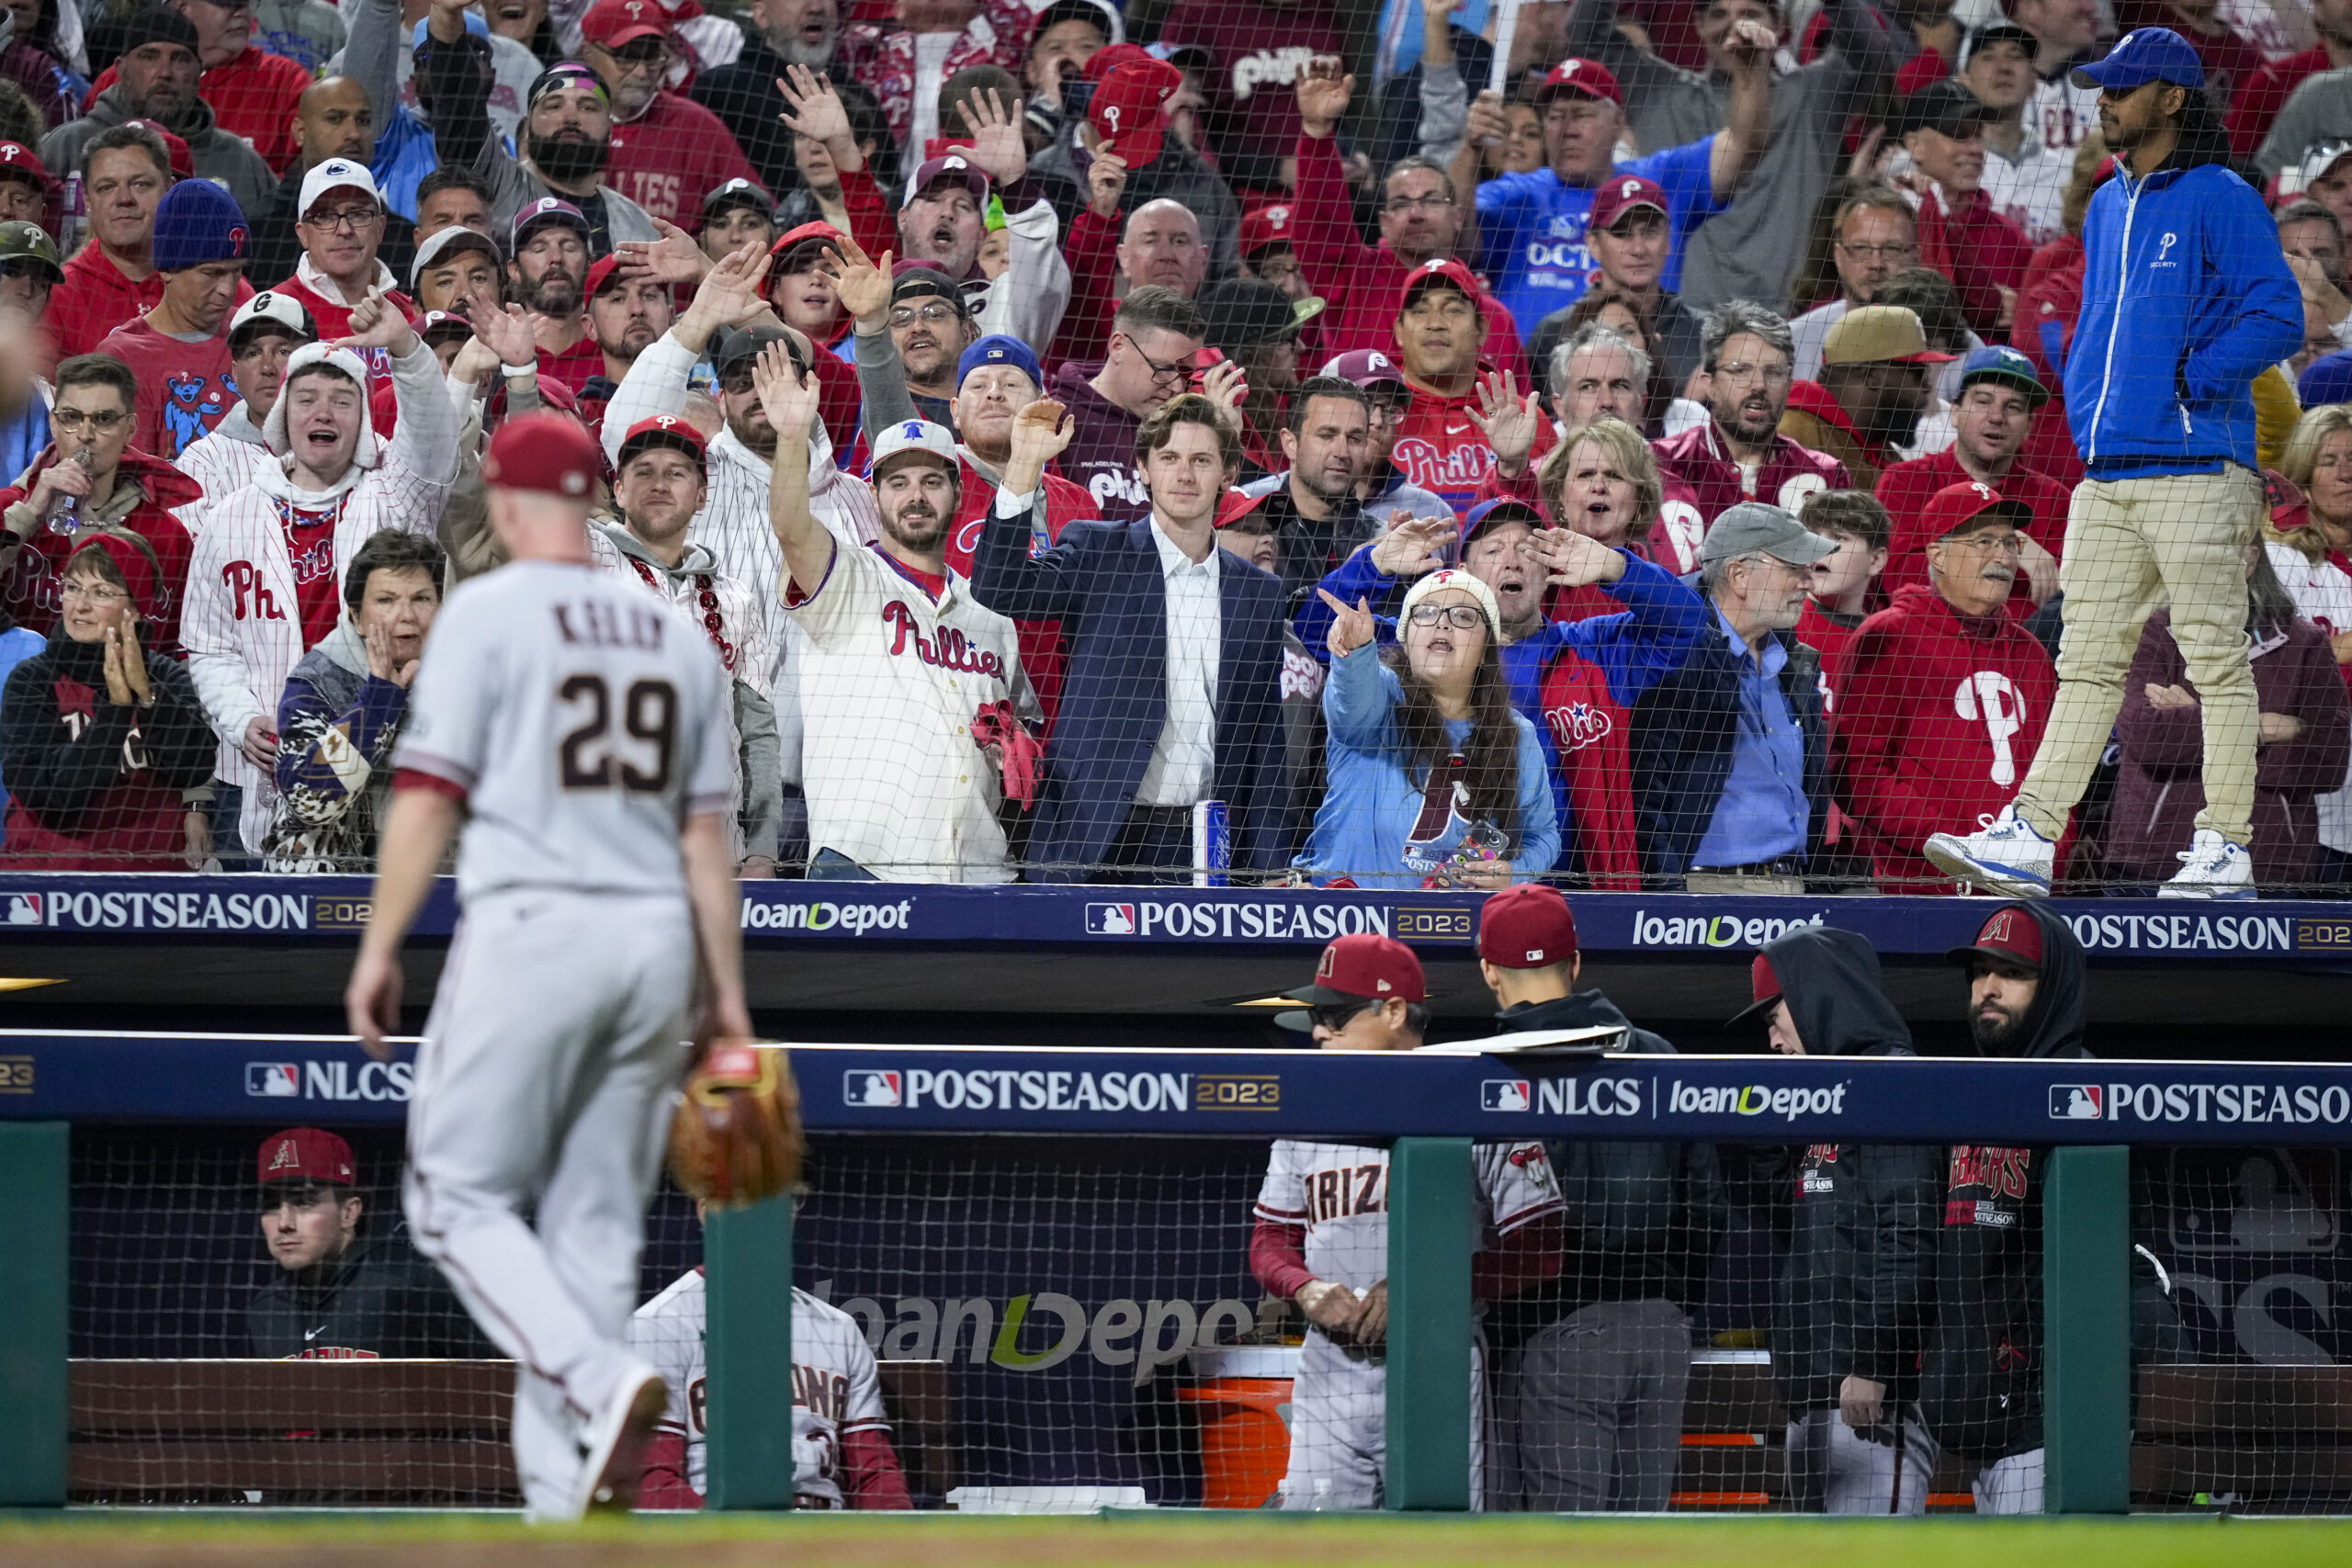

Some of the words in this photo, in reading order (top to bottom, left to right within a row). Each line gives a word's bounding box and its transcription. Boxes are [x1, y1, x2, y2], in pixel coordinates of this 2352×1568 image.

[1103, 106, 1120, 132] P
[1, 144, 20, 161] P
[24, 227, 43, 249] P
[230, 228, 246, 256] P
[2159, 232, 2177, 261] P
[253, 293, 272, 313] G
[425, 310, 447, 329] P
[1368, 352, 1388, 372] P
[656, 415, 677, 429] P
[1434, 570, 1454, 584] P
[554, 602, 665, 650] KELLY
[559, 673, 680, 793] 29
[1954, 671, 2027, 786] P
[47, 891, 309, 930] POSTSEASON
[741, 897, 911, 937] loanDepot
[1140, 902, 1391, 939] POSTSEASON
[1396, 915, 1471, 933] 2023
[2061, 914, 2291, 951] OSTSEASON
[305, 1061, 416, 1102] NLCS
[905, 1068, 1190, 1111] POSTSEASON
[1196, 1082, 1282, 1103] 2023
[1537, 1076, 1642, 1116] NLCS
[1668, 1078, 1847, 1122] loanDepot
